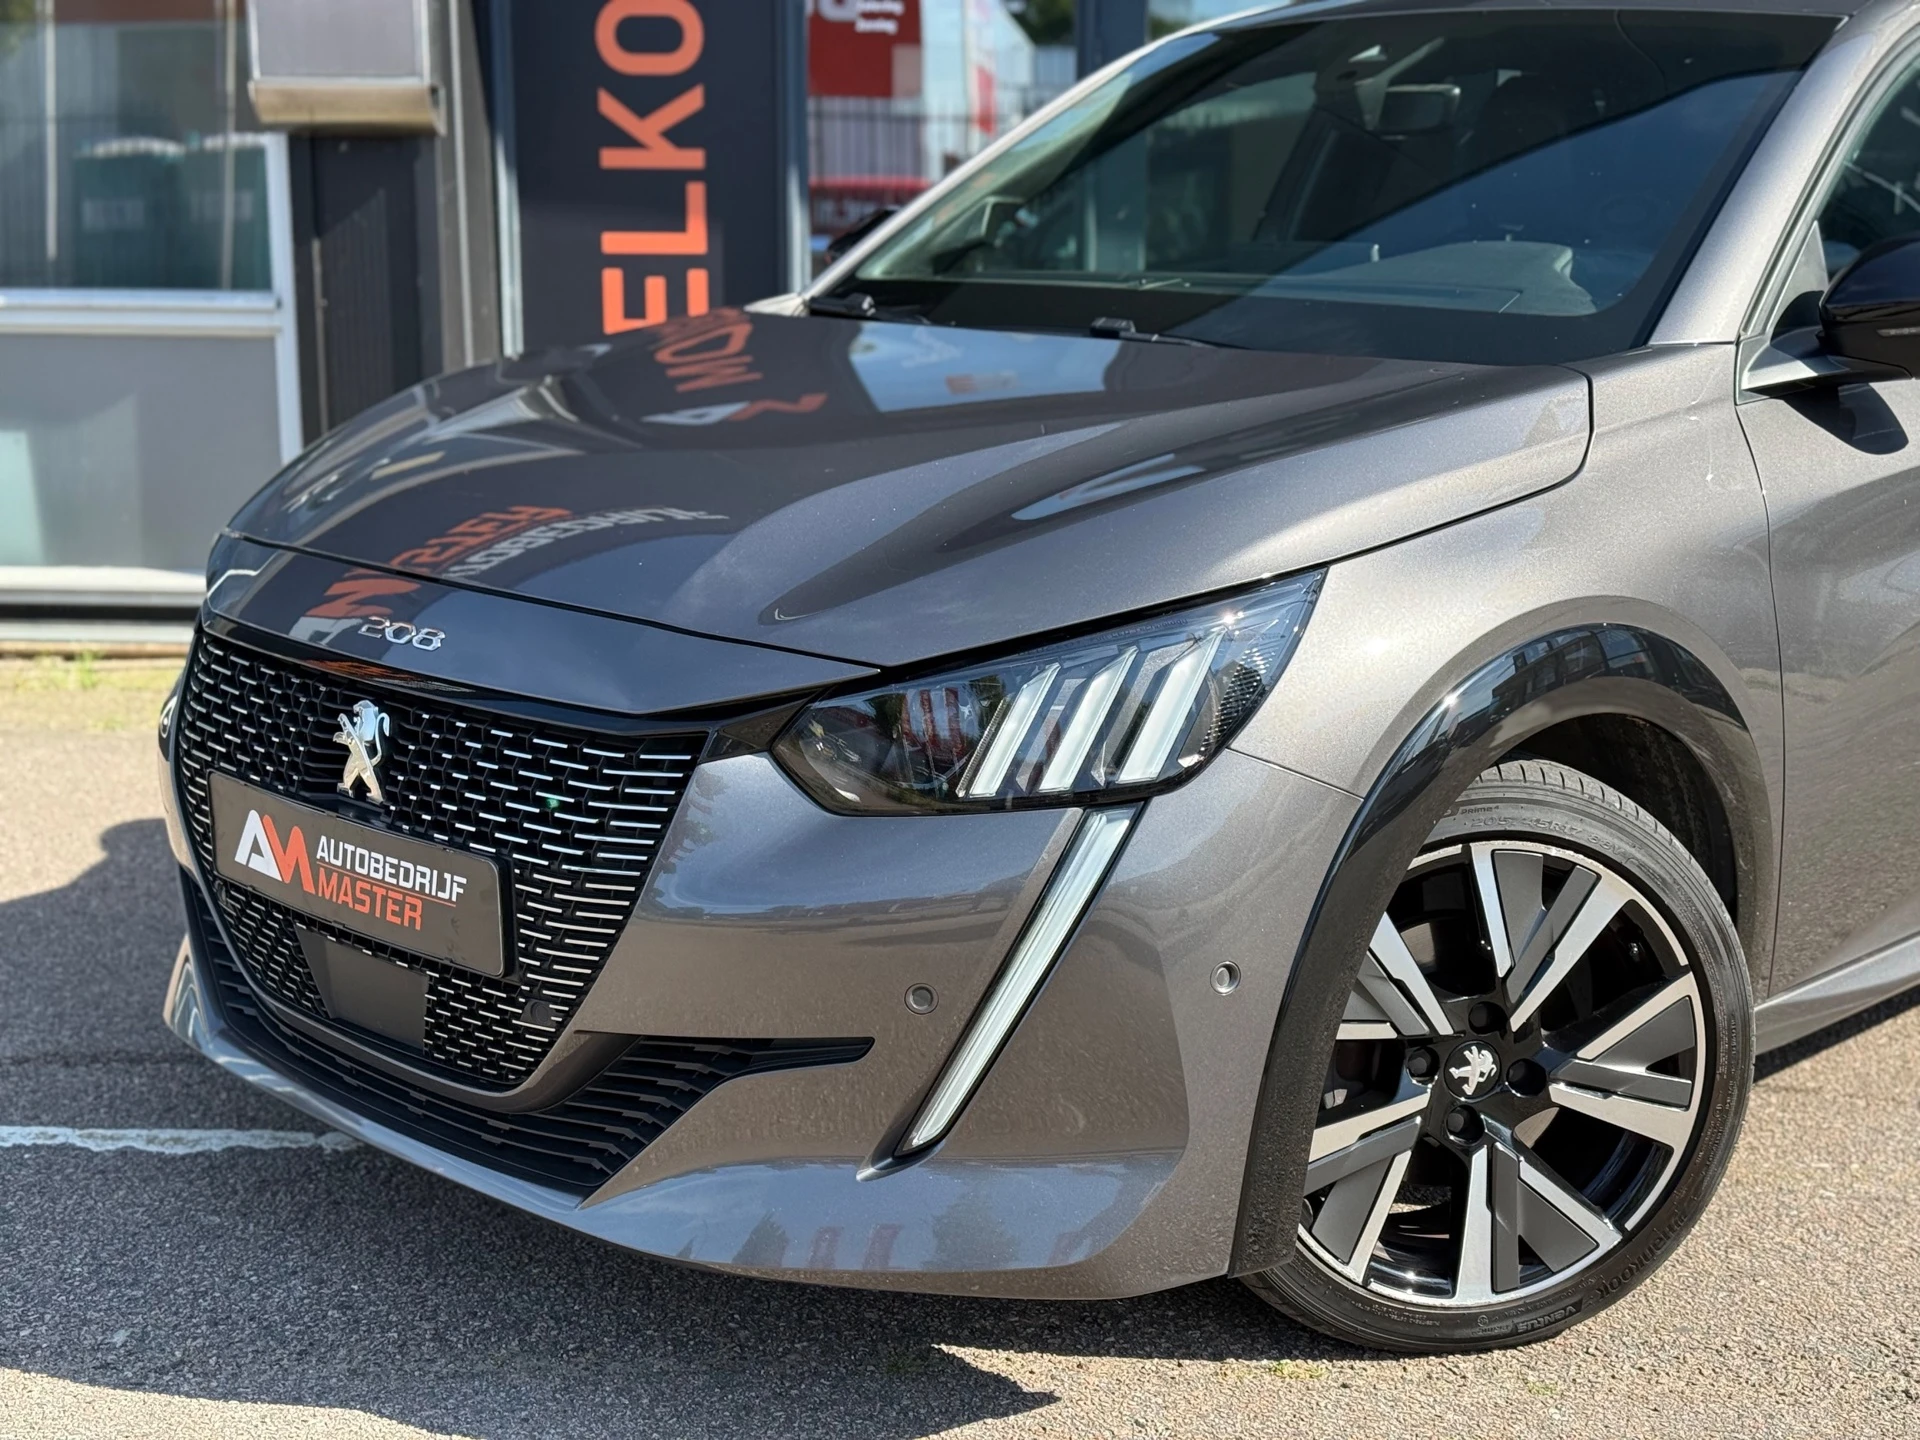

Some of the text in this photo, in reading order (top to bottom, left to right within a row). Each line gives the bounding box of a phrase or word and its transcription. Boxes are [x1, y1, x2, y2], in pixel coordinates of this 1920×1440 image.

[358, 616, 446, 651] 208
[316, 835, 468, 902] AUTOBEDRIJF
[317, 867, 423, 931] MASTER
